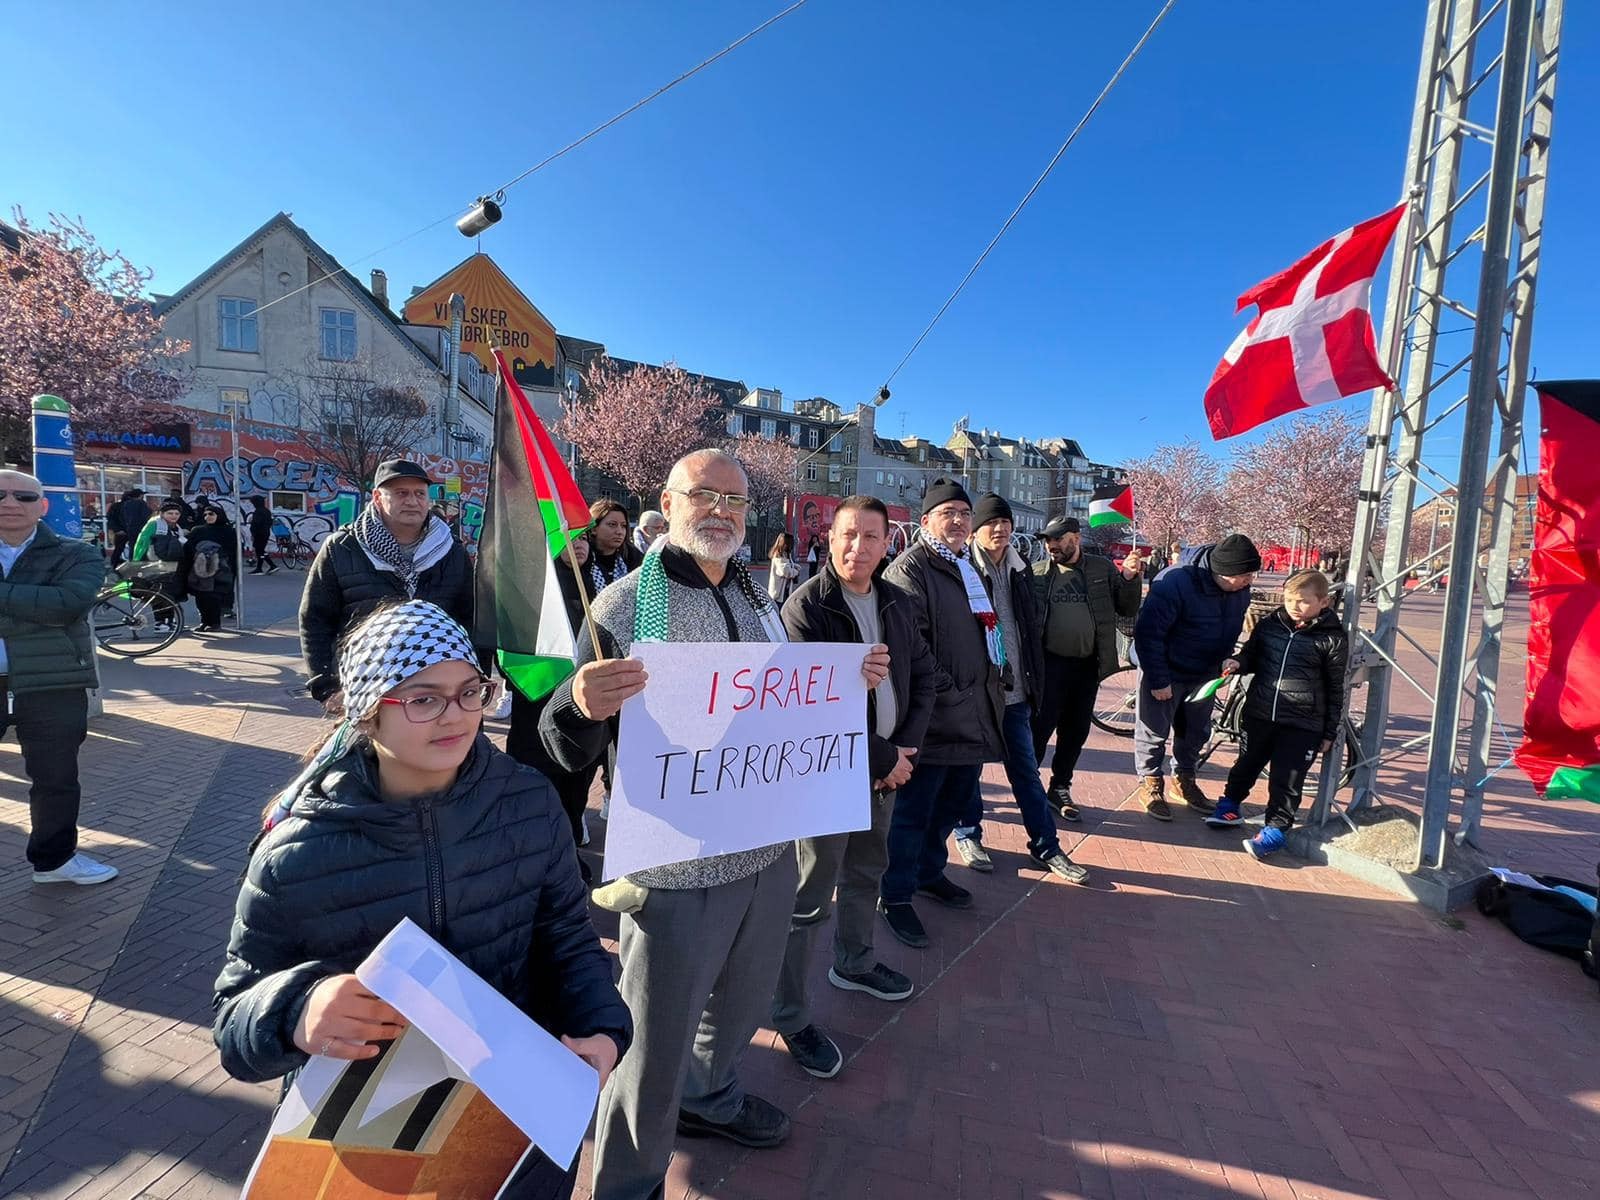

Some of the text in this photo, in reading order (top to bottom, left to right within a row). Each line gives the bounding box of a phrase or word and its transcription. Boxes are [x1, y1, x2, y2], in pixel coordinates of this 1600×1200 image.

[434, 302, 508, 328] VI LSKER
[1051, 590, 1088, 604] adida
[708, 665, 841, 714] ISRAEL
[655, 731, 864, 799] TERRORSTAT
